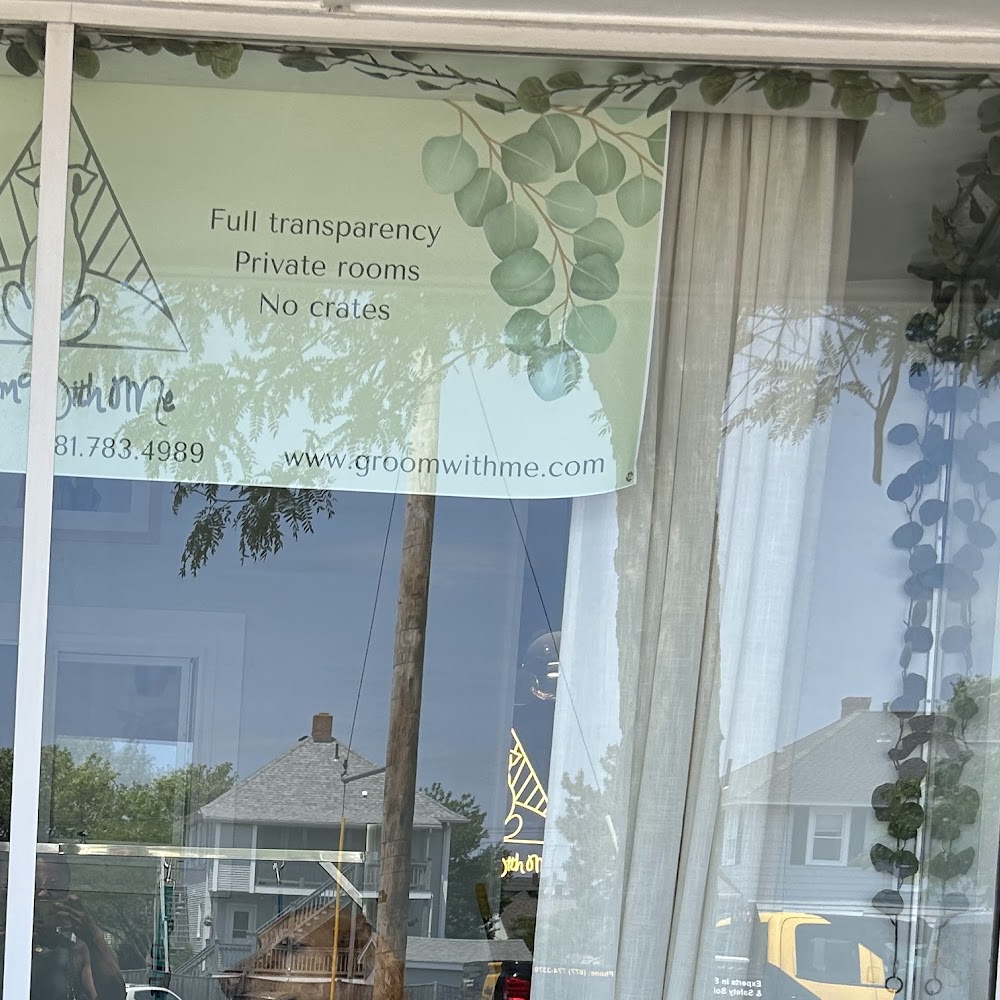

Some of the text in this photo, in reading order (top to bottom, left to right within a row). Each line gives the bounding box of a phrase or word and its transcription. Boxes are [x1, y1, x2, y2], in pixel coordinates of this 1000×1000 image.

[211, 208, 442, 248] Full transparency
[235, 251, 420, 282] Private rooms
[260, 293, 390, 321] No crates
[109, 375, 176, 427] Me
[54, 435, 204, 465] 81.783.4989
[284, 450, 605, 478] www.groomwithme.com
